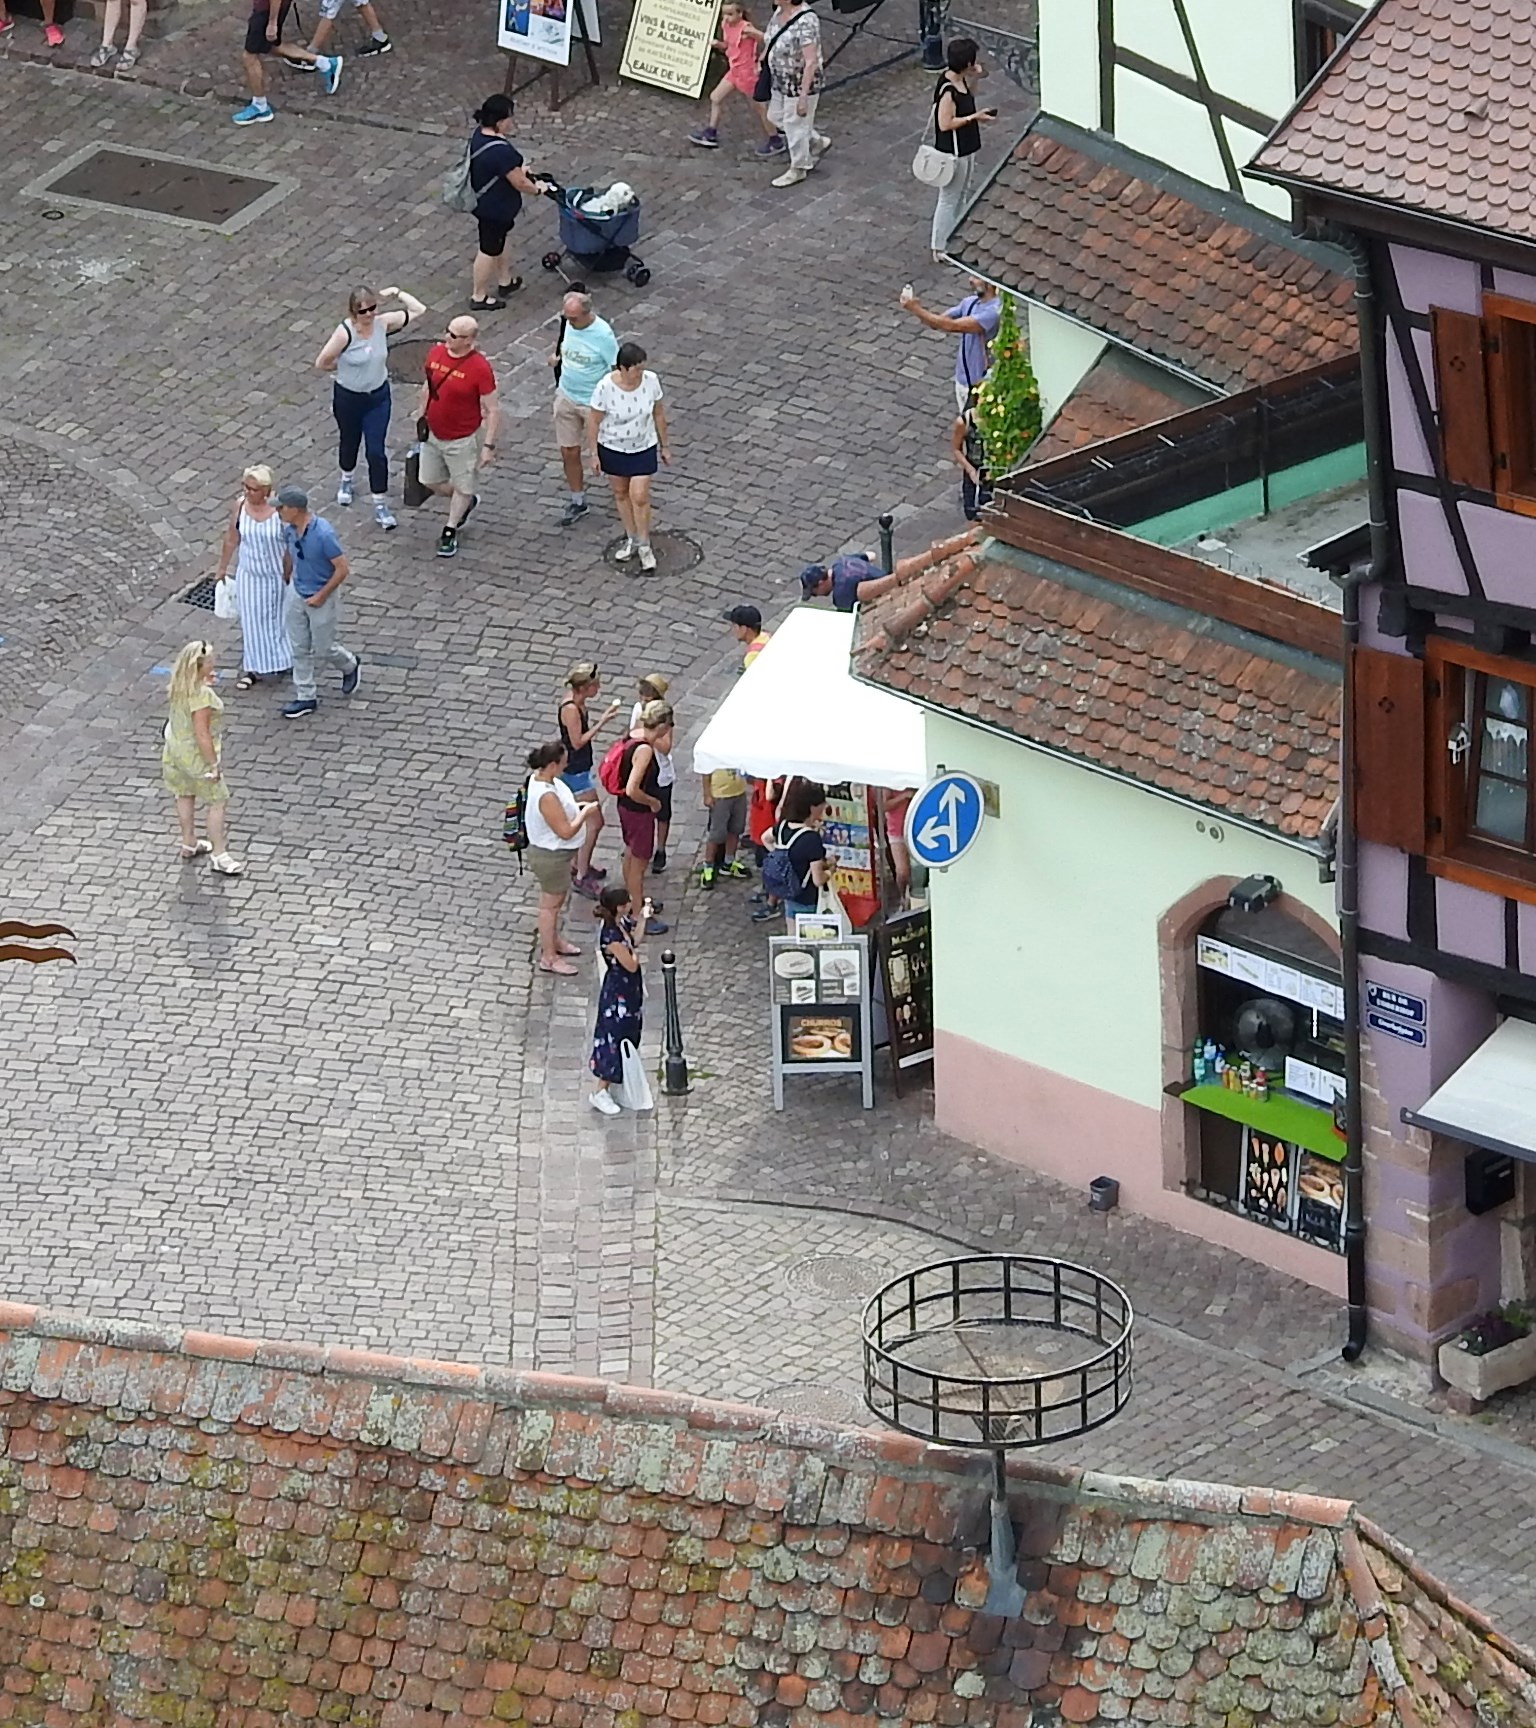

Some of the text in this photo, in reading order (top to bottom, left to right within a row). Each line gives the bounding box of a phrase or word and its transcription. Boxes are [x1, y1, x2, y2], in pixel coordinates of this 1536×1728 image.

[640, 14, 658, 27] VINS
[660, 19, 666, 29] &
[658, 31, 695, 49] ALSACE
[633, 59, 691, 85] EAUX DE VIE
